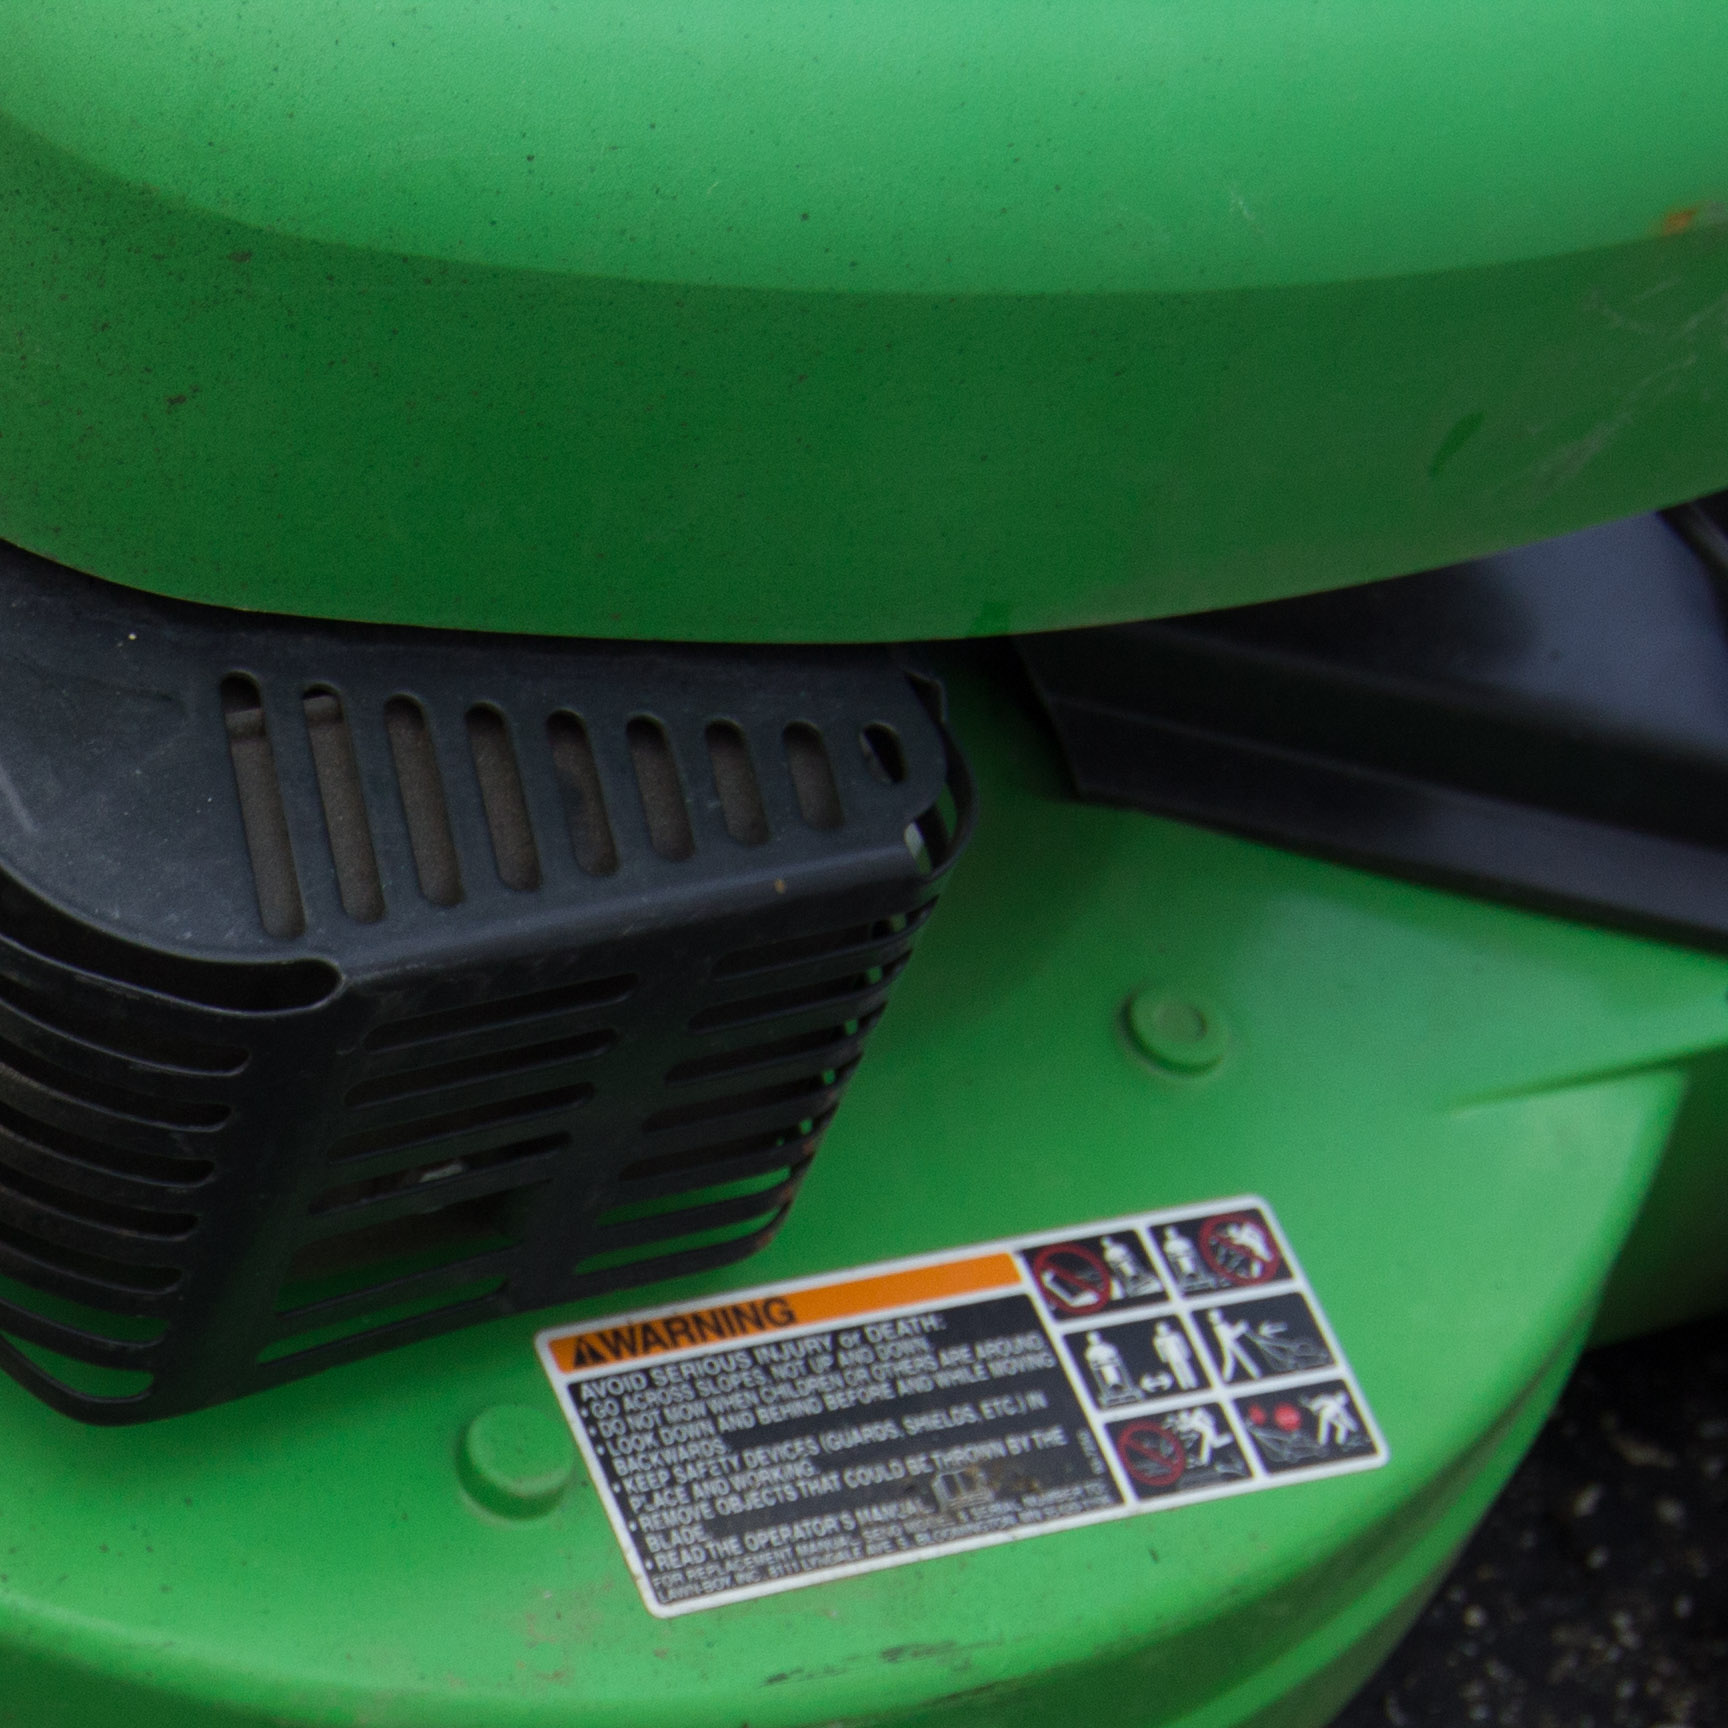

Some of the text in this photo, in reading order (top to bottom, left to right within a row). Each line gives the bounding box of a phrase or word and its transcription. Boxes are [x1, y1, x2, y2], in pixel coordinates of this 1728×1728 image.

[579, 1313, 948, 1400] AVOID SERIOUS INJURY or DEATH:
[599, 1297, 794, 1360] WARNING
[588, 1399, 621, 1419] GO
[620, 1384, 697, 1413] ACROSS
[770, 1360, 810, 1382] NOT
[808, 1354, 837, 1373] UP
[835, 1347, 876, 1369] AND
[596, 1418, 628, 1438] DO
[626, 1410, 663, 1432] NOT
[662, 1401, 709, 1424] MOW
[706, 1390, 761, 1415] WHEN
[757, 1373, 845, 1404] CHILDREN
[841, 1366, 871, 1387] OR
[869, 1353, 939, 1381] OTHERS
[936, 1345, 974, 1367] ARE
[604, 1431, 659, 1456] LOOK
[658, 1419, 717, 1445] DOWN
[715, 1410, 758, 1433] AND
[755, 1396, 824, 1424] BEHIND
[822, 1382, 896, 1411] BEFORE
[893, 1374, 935, 1397] AND
[931, 1363, 990, 1389] WHILE
[620, 1469, 675, 1495] KEEP
[672, 1454, 744, 1483] SAFETY
[742, 1438, 822, 1468] DEVICES
[1023, 1389, 1048, 1410] IN
[637, 1426, 1068, 1532] REMOVE OBJECTS THAT COULD BE THROWN BY THE
[627, 1486, 690, 1513] PLACE
[689, 1477, 732, 1500] AND
[651, 1571, 687, 1590] FOR
[685, 1548, 796, 1582] REPLACEMENT
[653, 1544, 709, 1571] READ
[704, 1536, 743, 1559] THE
